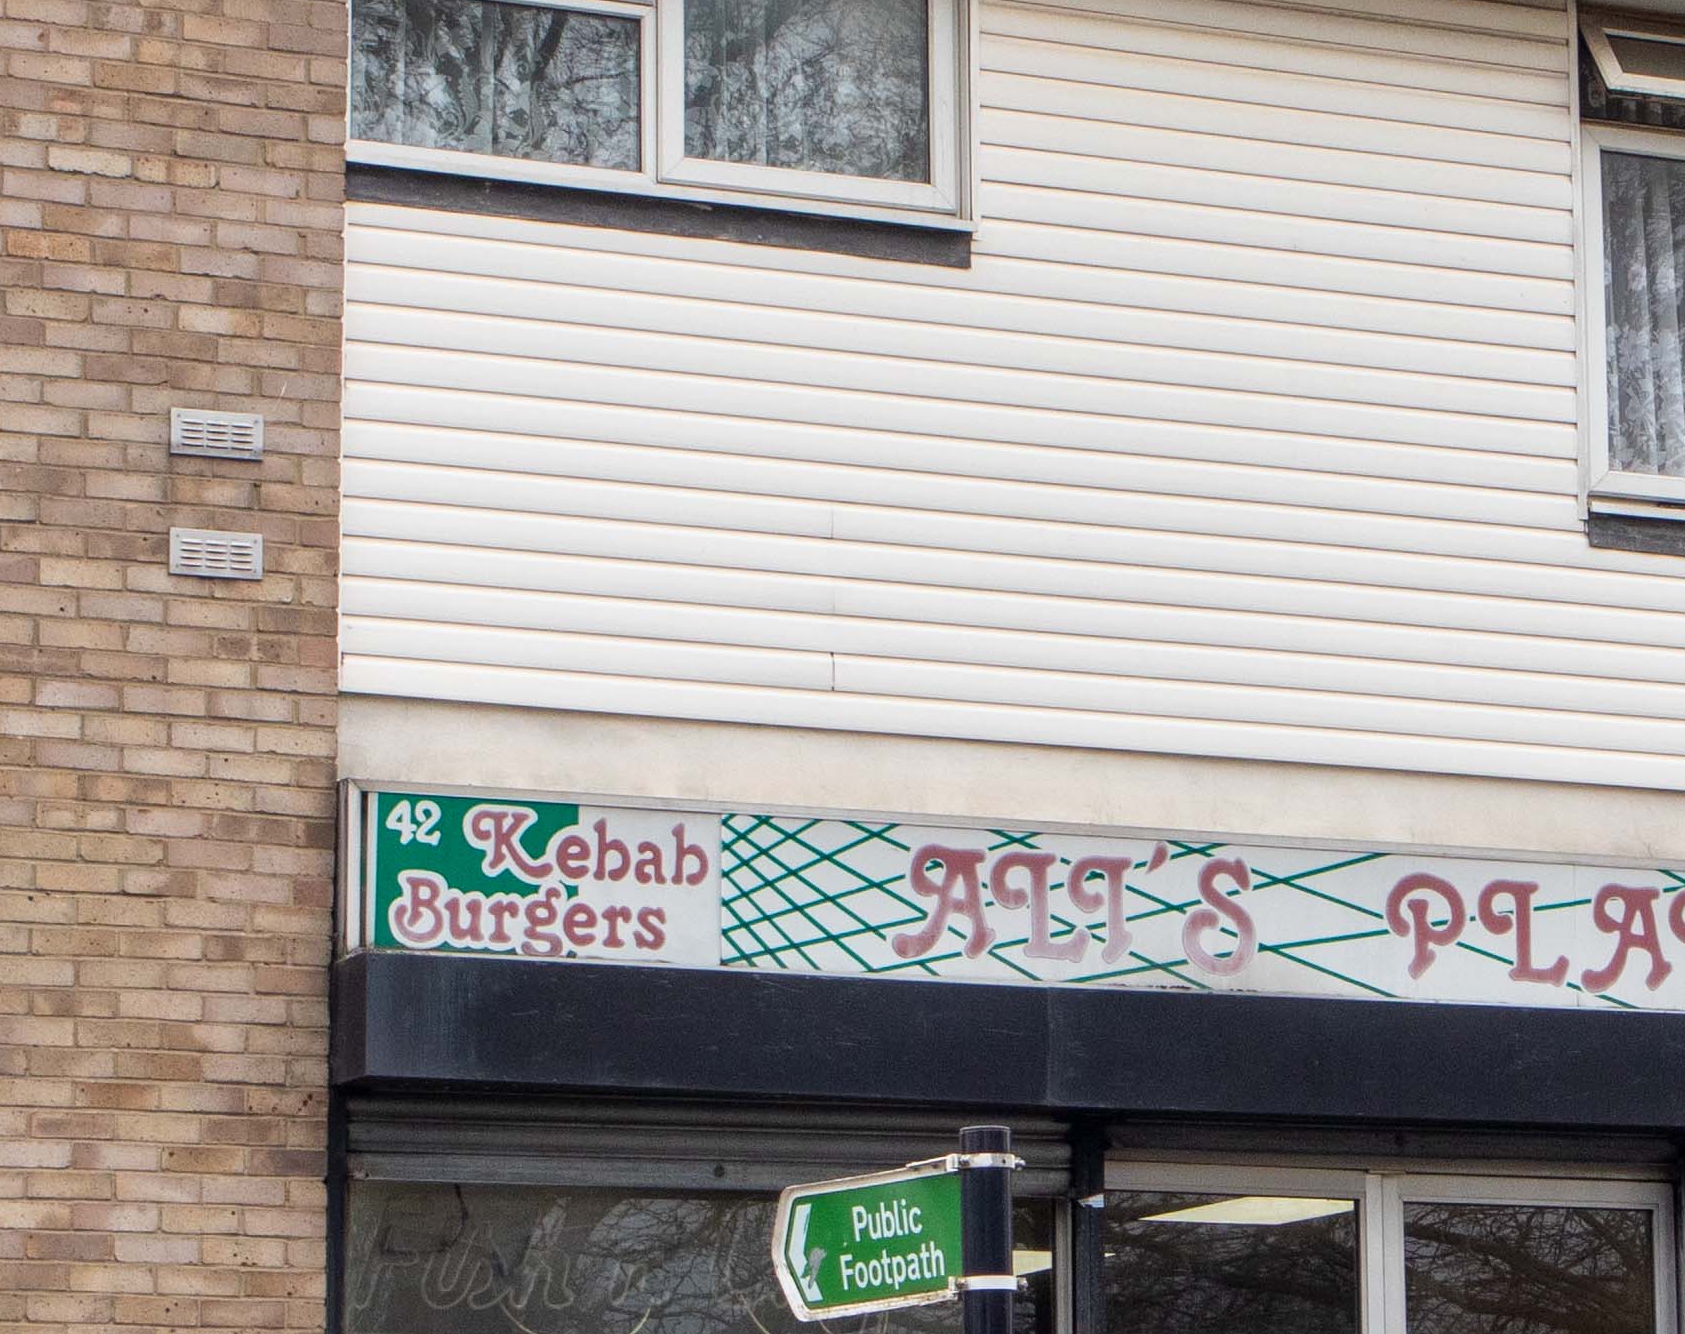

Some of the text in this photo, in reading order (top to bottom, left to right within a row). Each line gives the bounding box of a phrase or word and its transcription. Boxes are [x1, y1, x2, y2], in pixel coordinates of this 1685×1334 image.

[385, 799, 442, 846] 42
[468, 808, 709, 887] Kebab
[393, 875, 668, 958] Burgers
[852, 1198, 923, 1243] Public
[839, 1240, 946, 1291] Footpath
